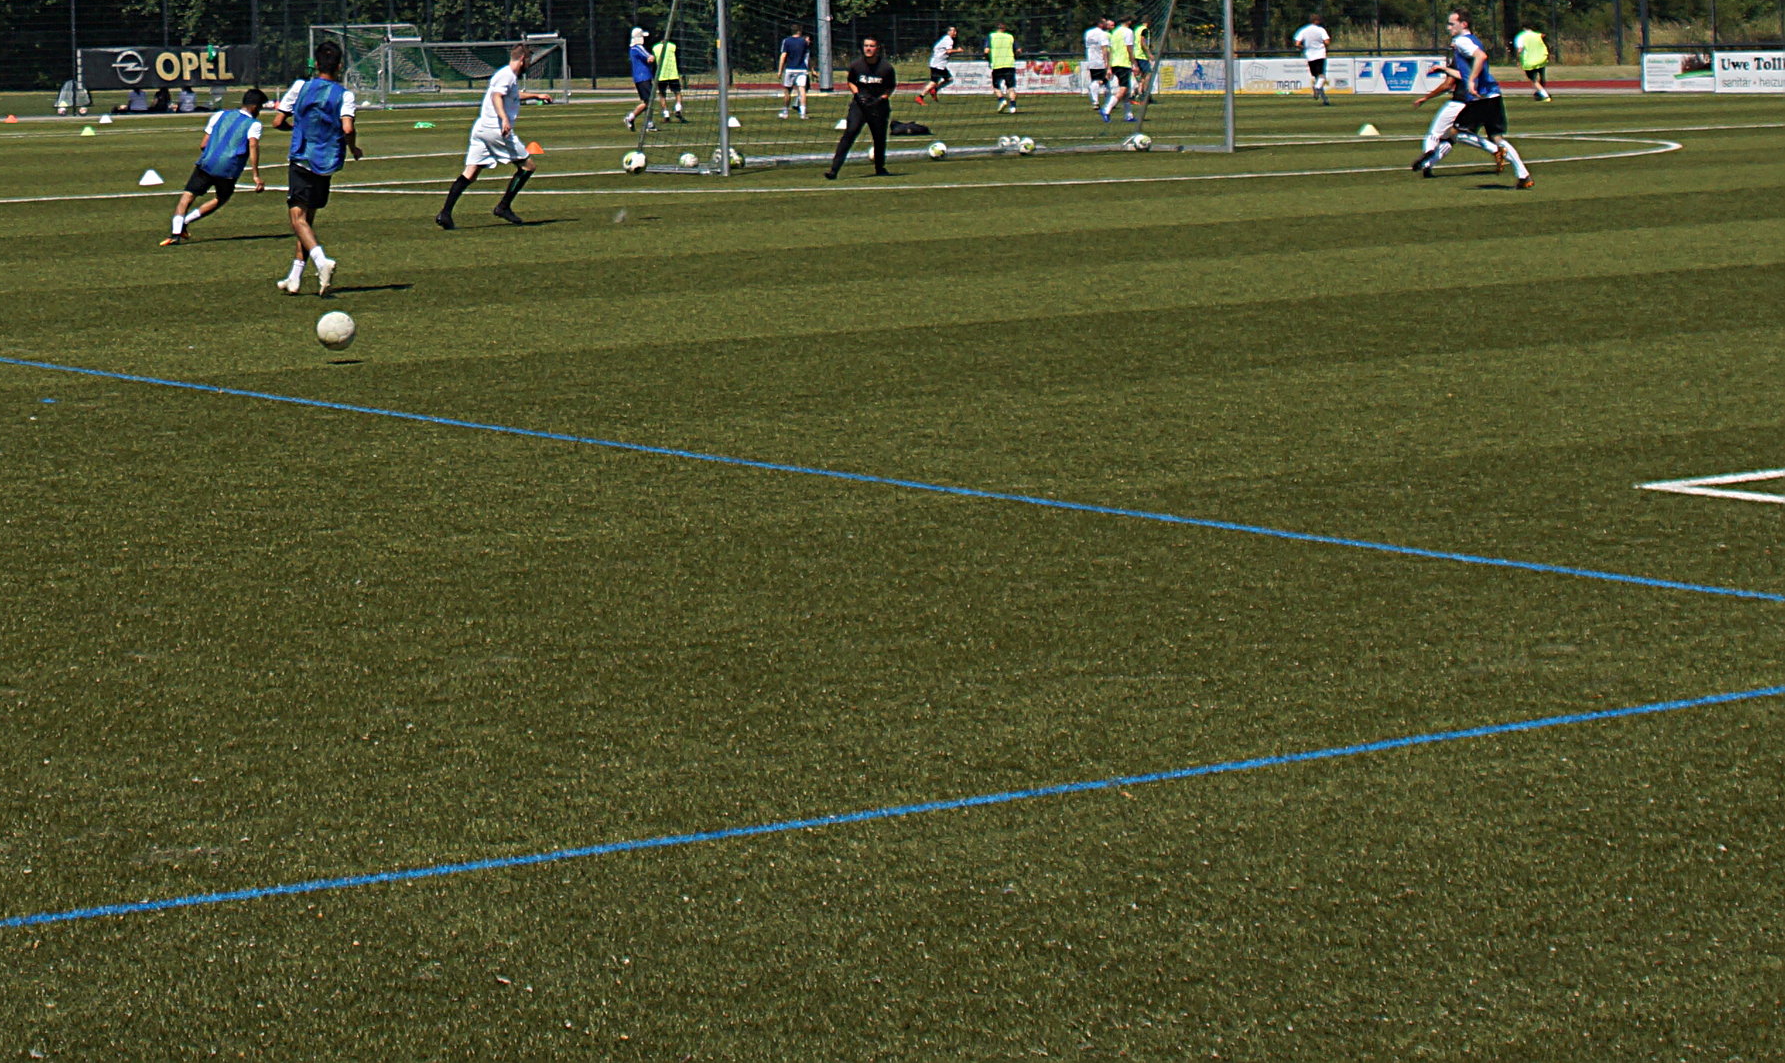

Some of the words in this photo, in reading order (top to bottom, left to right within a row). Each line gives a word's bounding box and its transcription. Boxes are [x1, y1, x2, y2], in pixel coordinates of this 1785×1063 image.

[154, 51, 234, 81] OPEL
[1721, 58, 1750, 71] Uwe
[1759, 77, 1785, 88] heizu
